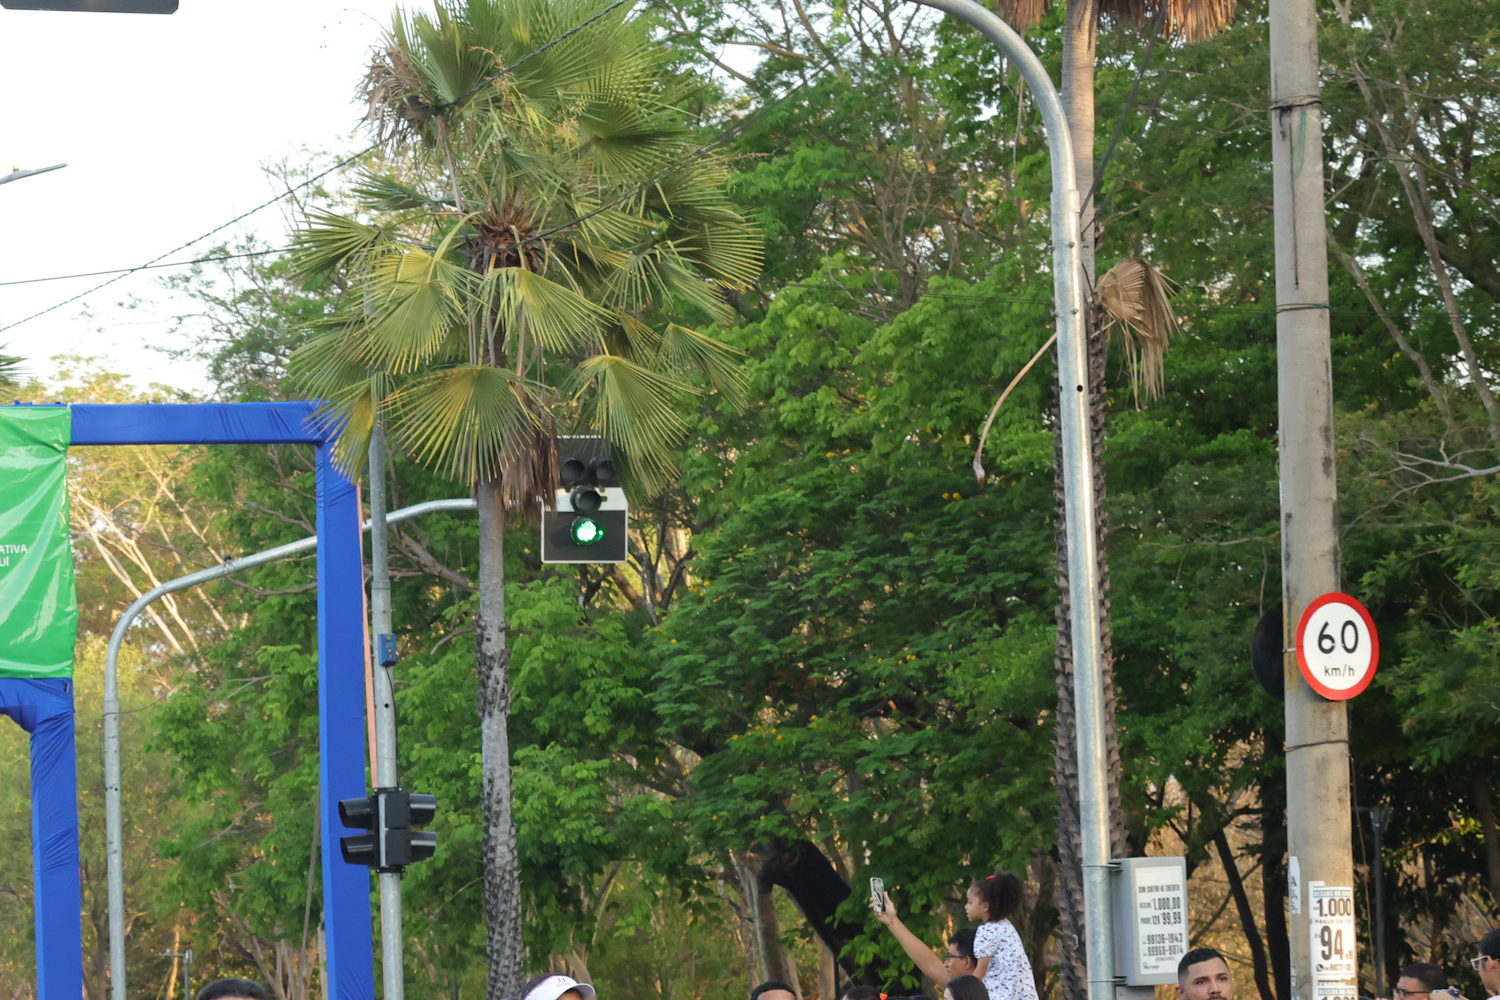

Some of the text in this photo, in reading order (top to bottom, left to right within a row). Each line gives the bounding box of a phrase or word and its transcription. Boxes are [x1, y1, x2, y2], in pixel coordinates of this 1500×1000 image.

[1317, 620, 1358, 654] 60
[1324, 664, 1355, 677] km/h
[1317, 898, 1351, 917] 1.000
[1320, 925, 1343, 960] 94
